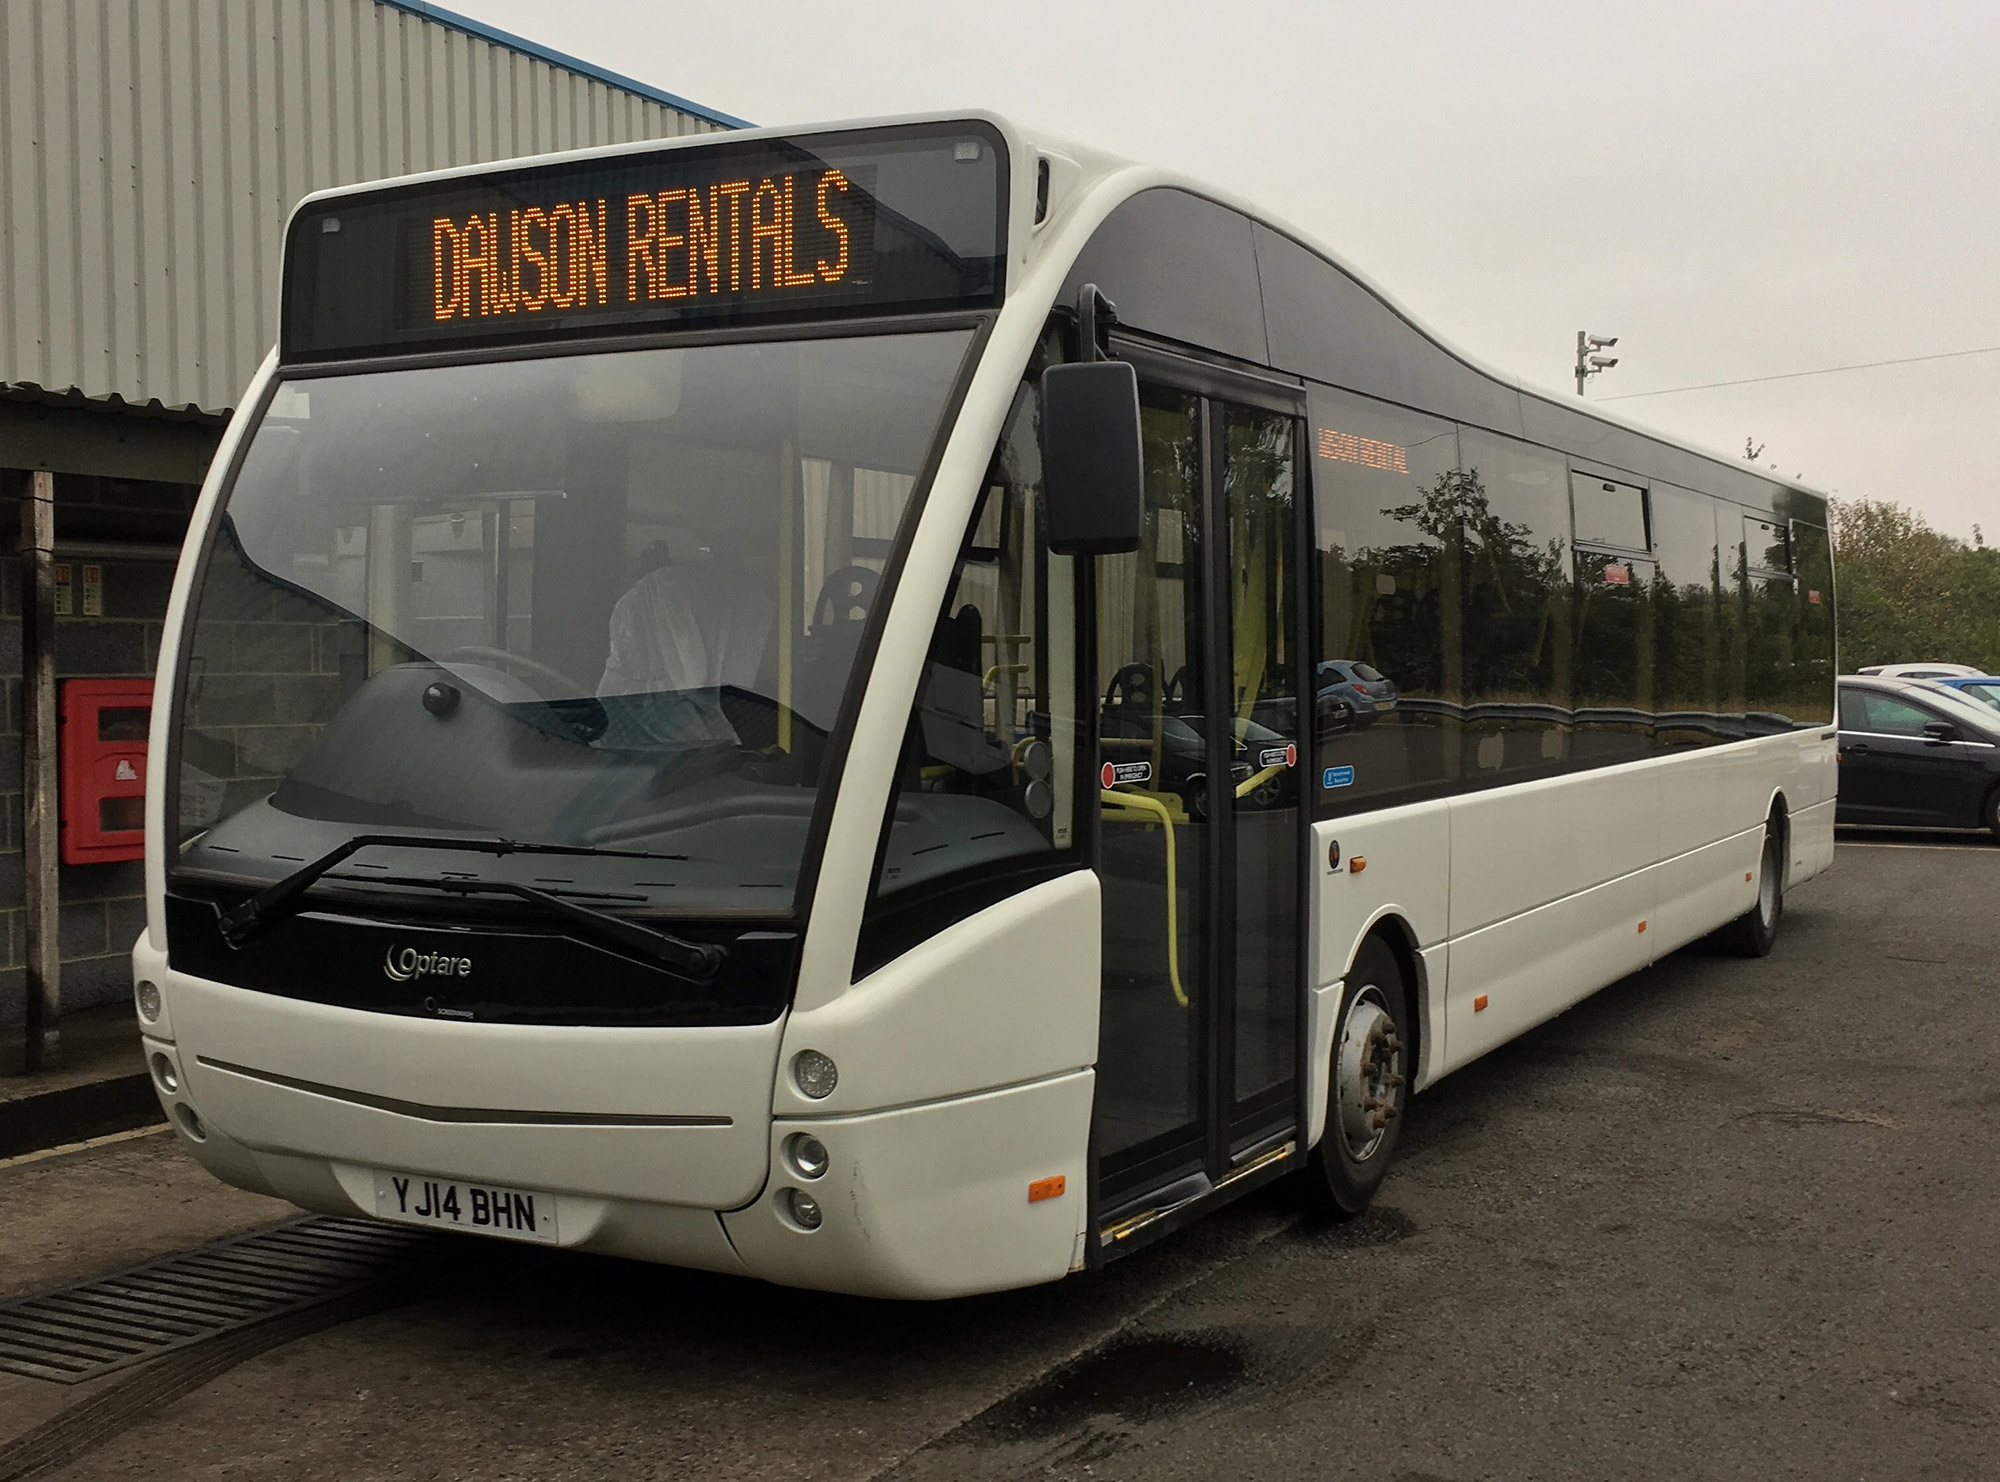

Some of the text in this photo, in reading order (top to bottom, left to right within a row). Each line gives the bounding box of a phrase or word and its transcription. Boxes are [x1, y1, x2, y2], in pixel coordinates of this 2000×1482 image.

[433, 168, 849, 320] DAWSON RENTALS
[399, 947, 472, 980] Optare
[392, 1176, 536, 1232] YJ14 BHN
